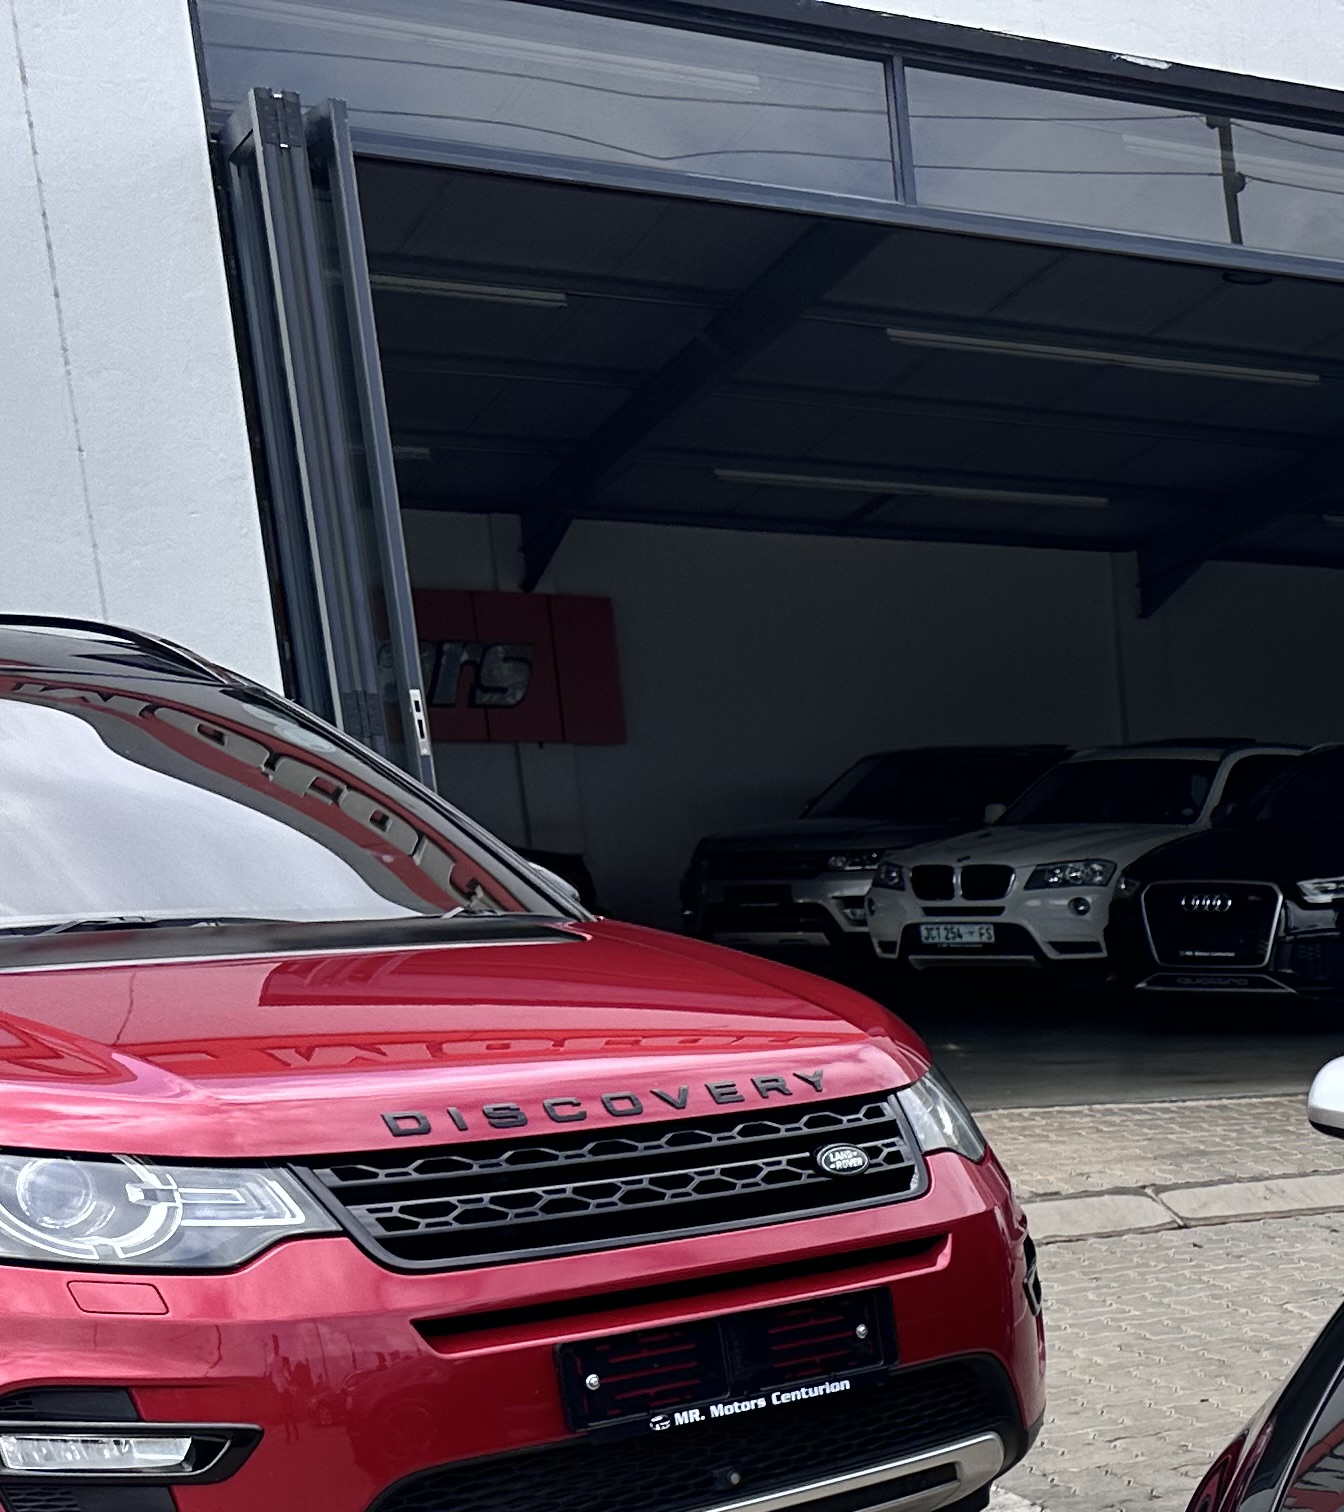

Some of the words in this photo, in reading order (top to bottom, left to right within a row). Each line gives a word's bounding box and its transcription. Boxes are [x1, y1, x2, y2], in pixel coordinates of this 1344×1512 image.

[380, 1069, 824, 1138] DISCOVERY
[829, 1150, 852, 1162] LAND
[836, 1157, 863, 1170] ROVER
[674, 1410, 705, 1427] MR.
[710, 1396, 766, 1419] Motors
[771, 1379, 851, 1406] Centurion
